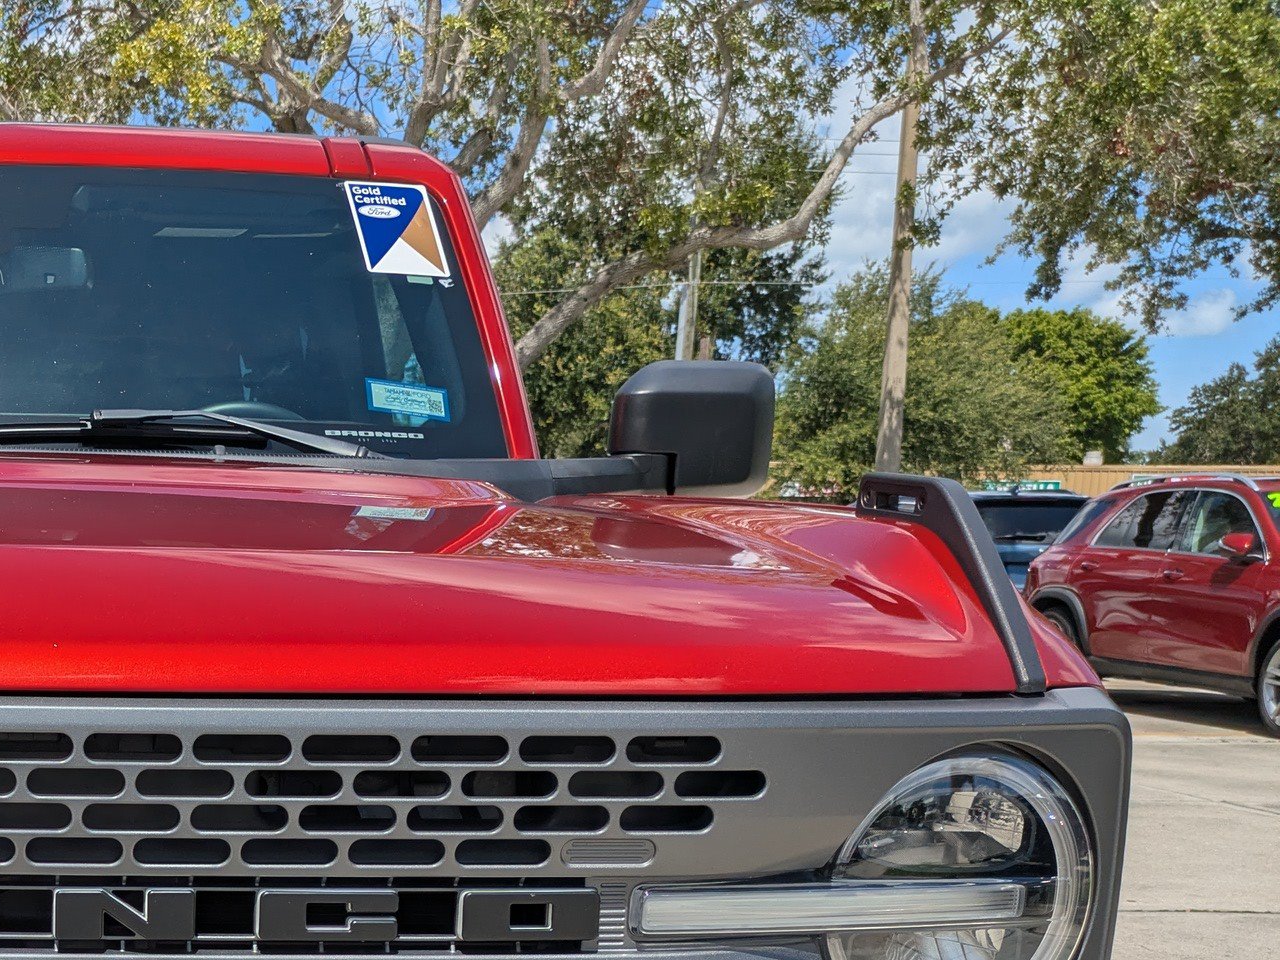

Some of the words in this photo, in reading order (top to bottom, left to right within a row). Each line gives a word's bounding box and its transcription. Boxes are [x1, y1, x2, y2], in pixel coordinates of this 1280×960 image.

[352, 186, 381, 195] Gold
[354, 195, 407, 206] Certified
[367, 207, 392, 216] Ford
[324, 429, 425, 439] BRONCO
